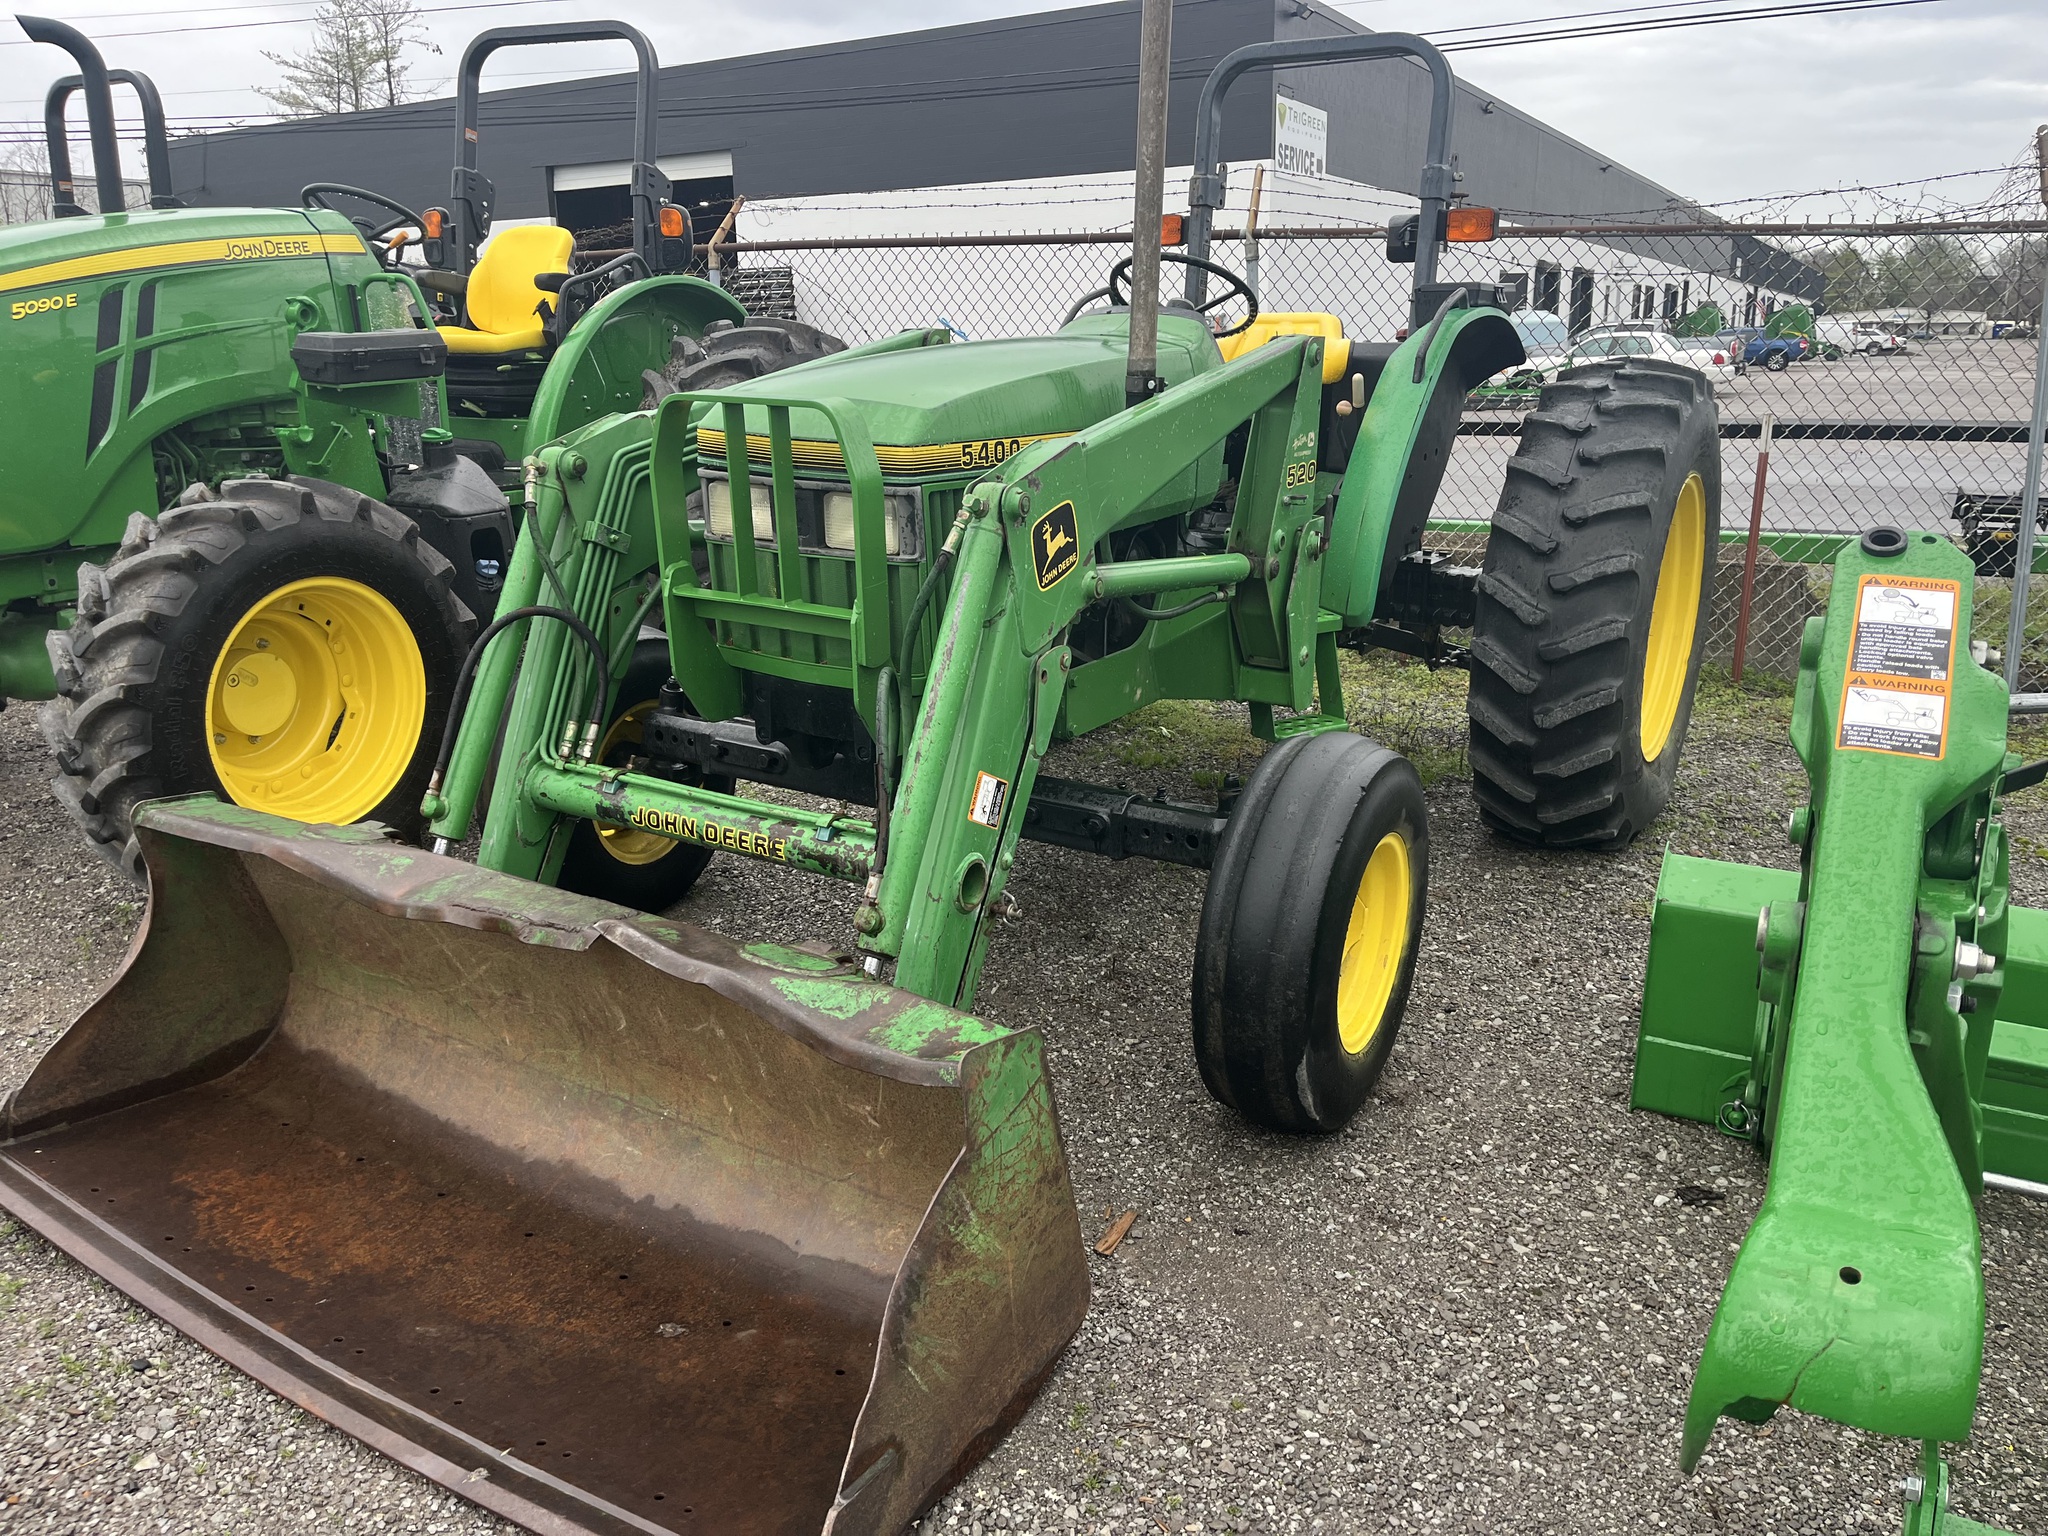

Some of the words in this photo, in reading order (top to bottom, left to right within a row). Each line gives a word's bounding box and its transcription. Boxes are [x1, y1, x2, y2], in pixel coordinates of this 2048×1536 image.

[1277, 142, 1315, 176] SERVICE
[224, 242, 264, 259] JOHN
[263, 240, 311, 256] DEERE
[12, 295, 64, 320] 5090
[66, 292, 78, 308] E
[961, 439, 1020, 468] 5400
[1286, 460, 1317, 488] 520
[1041, 567, 1058, 587] JOHN
[1058, 552, 1077, 573] DEERE
[1886, 578, 1955, 591] WARNING
[1873, 678, 1946, 693] WARNING
[631, 805, 697, 839] JOHN
[702, 820, 786, 861] DEERE
